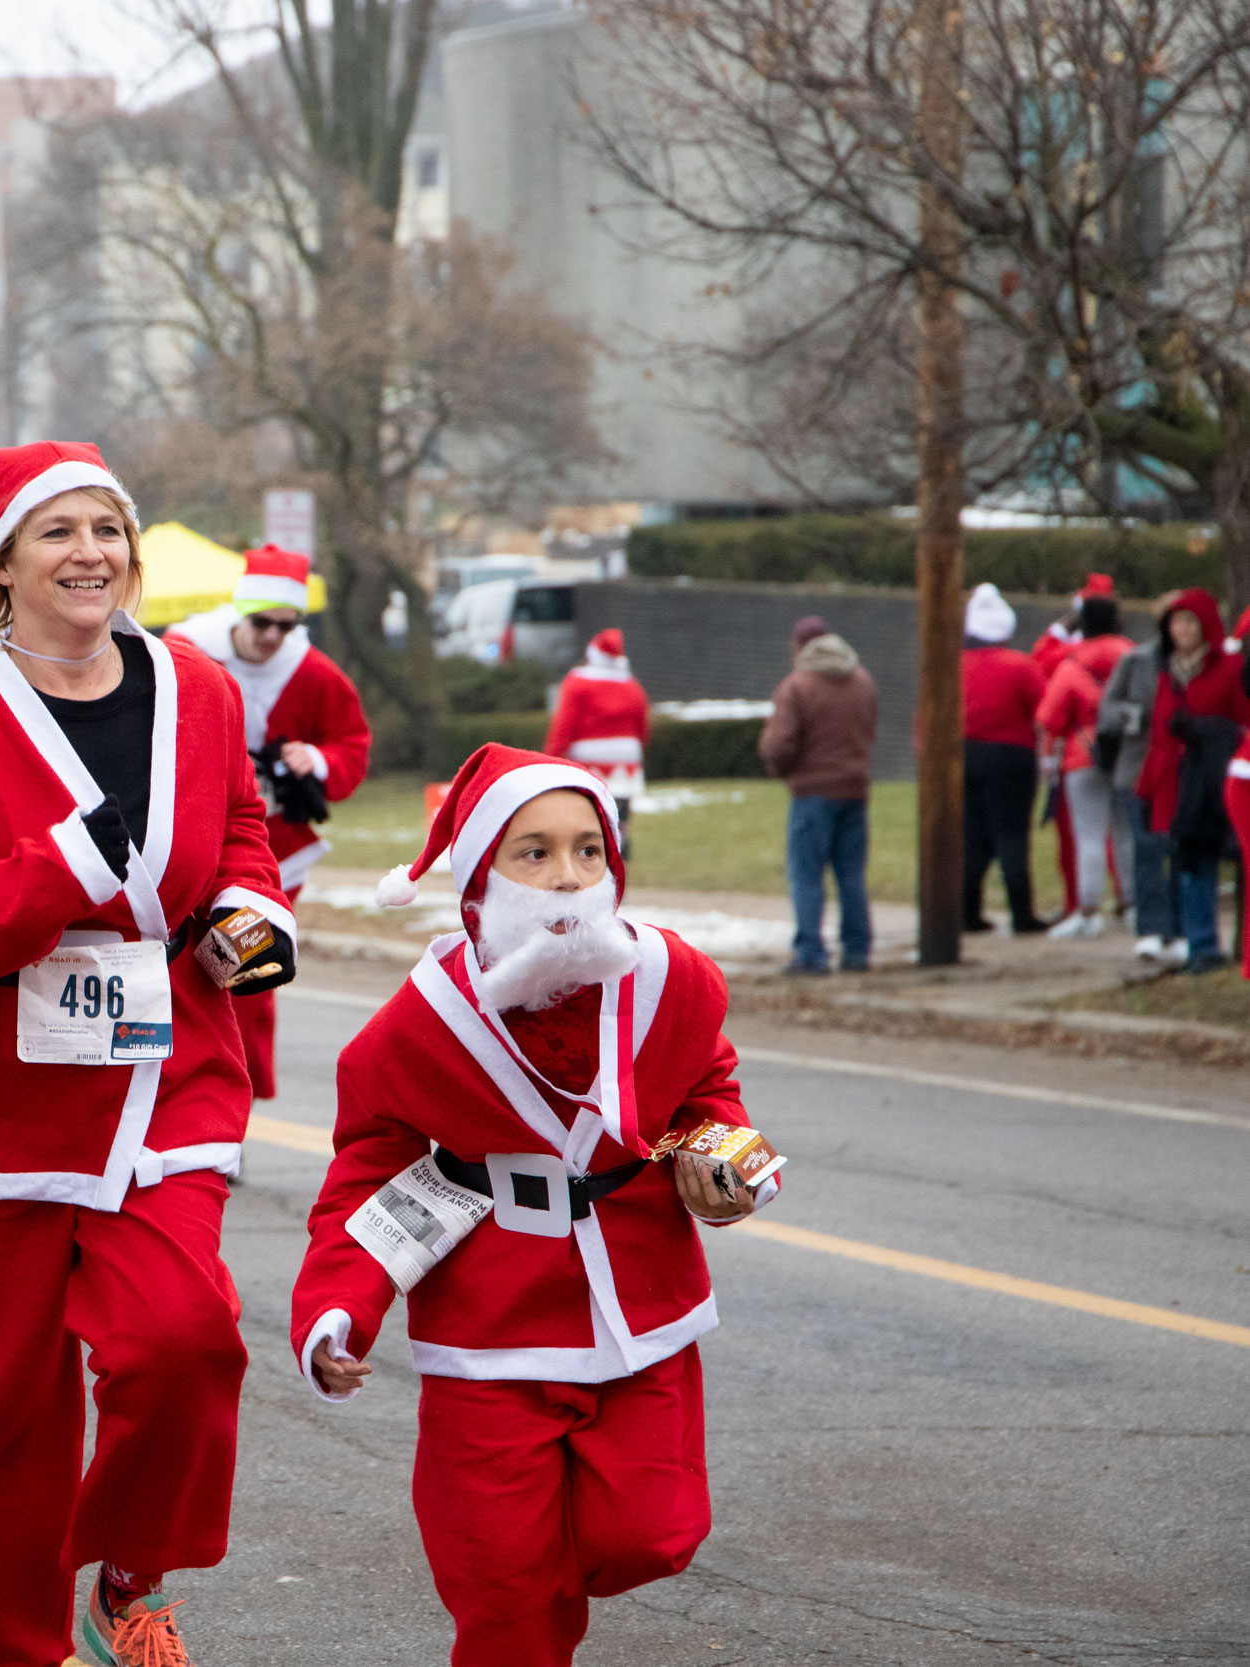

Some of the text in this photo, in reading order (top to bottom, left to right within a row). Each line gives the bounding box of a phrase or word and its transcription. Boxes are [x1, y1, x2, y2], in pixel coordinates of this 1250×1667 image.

[59, 974, 125, 1019] 496
[410, 1168, 482, 1224] GET OUT AND RU
[418, 1161, 441, 1187] YOUR
[441, 1184, 488, 1214] FREEDOM
[364, 1208, 383, 1227] $10
[383, 1222, 408, 1245] OFF
